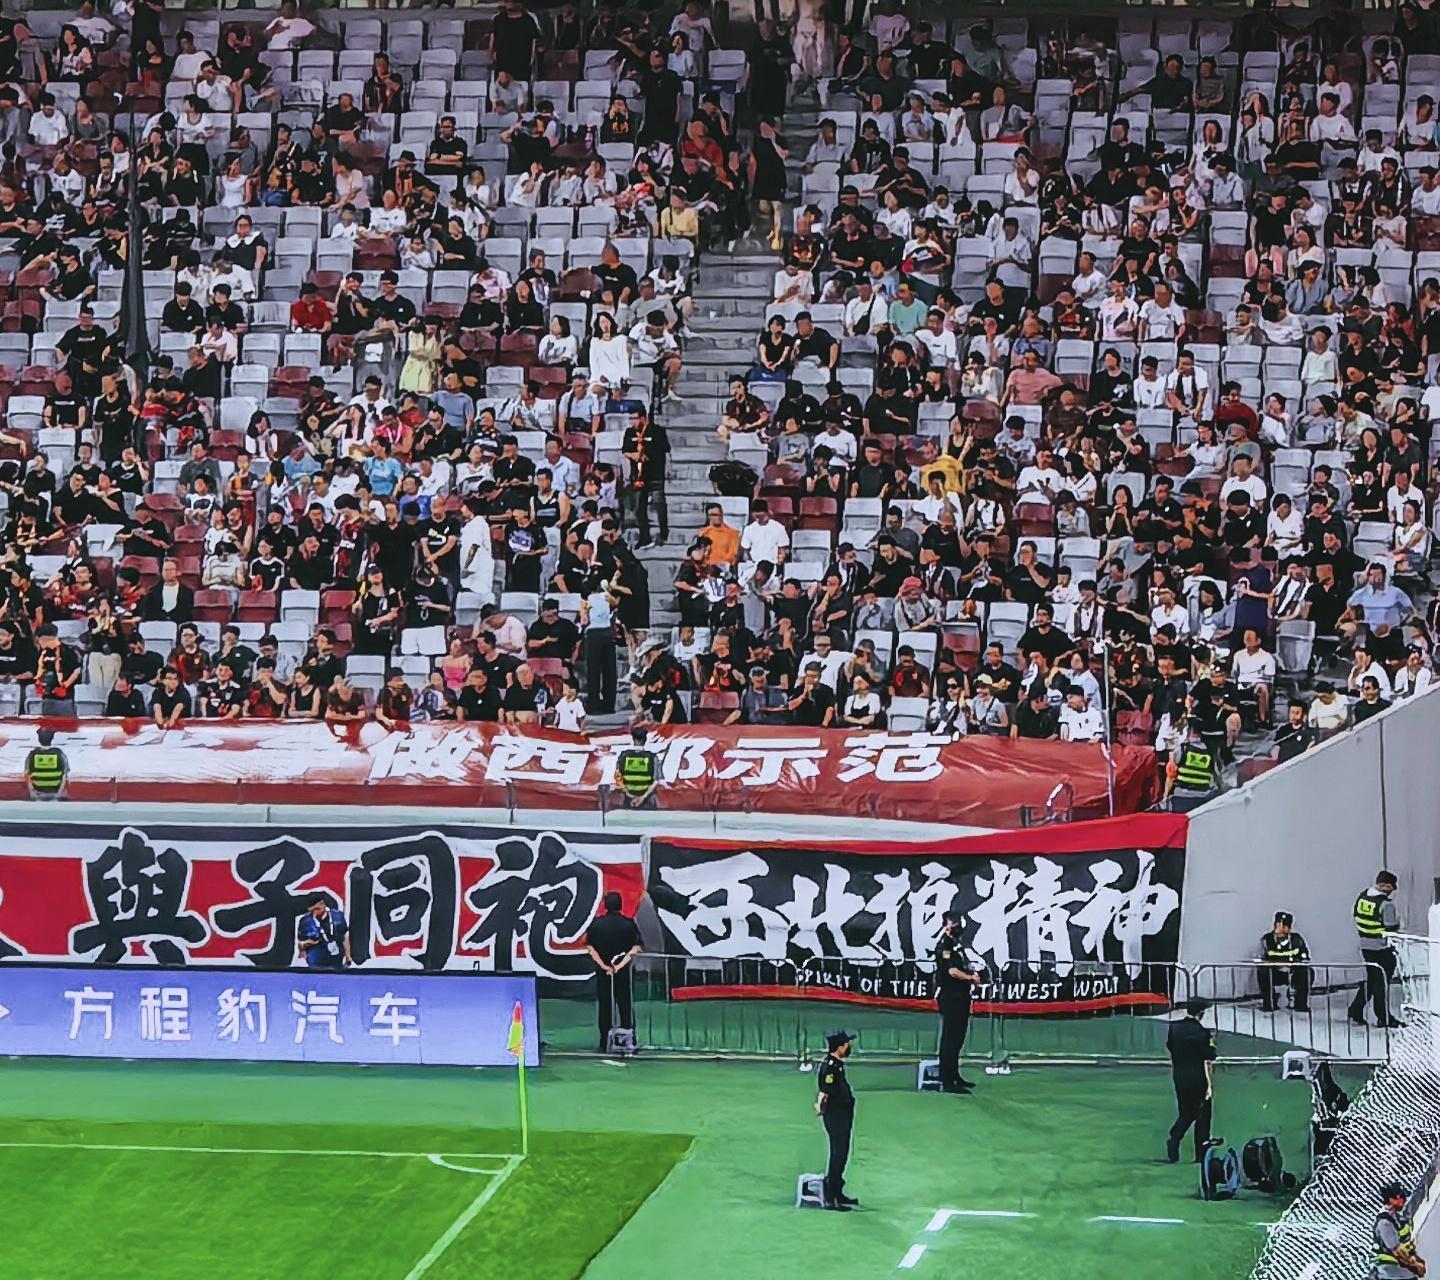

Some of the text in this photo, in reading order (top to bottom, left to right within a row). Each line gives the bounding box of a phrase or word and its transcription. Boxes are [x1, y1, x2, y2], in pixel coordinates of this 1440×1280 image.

[63, 987, 422, 1046] 方程豹汽车
